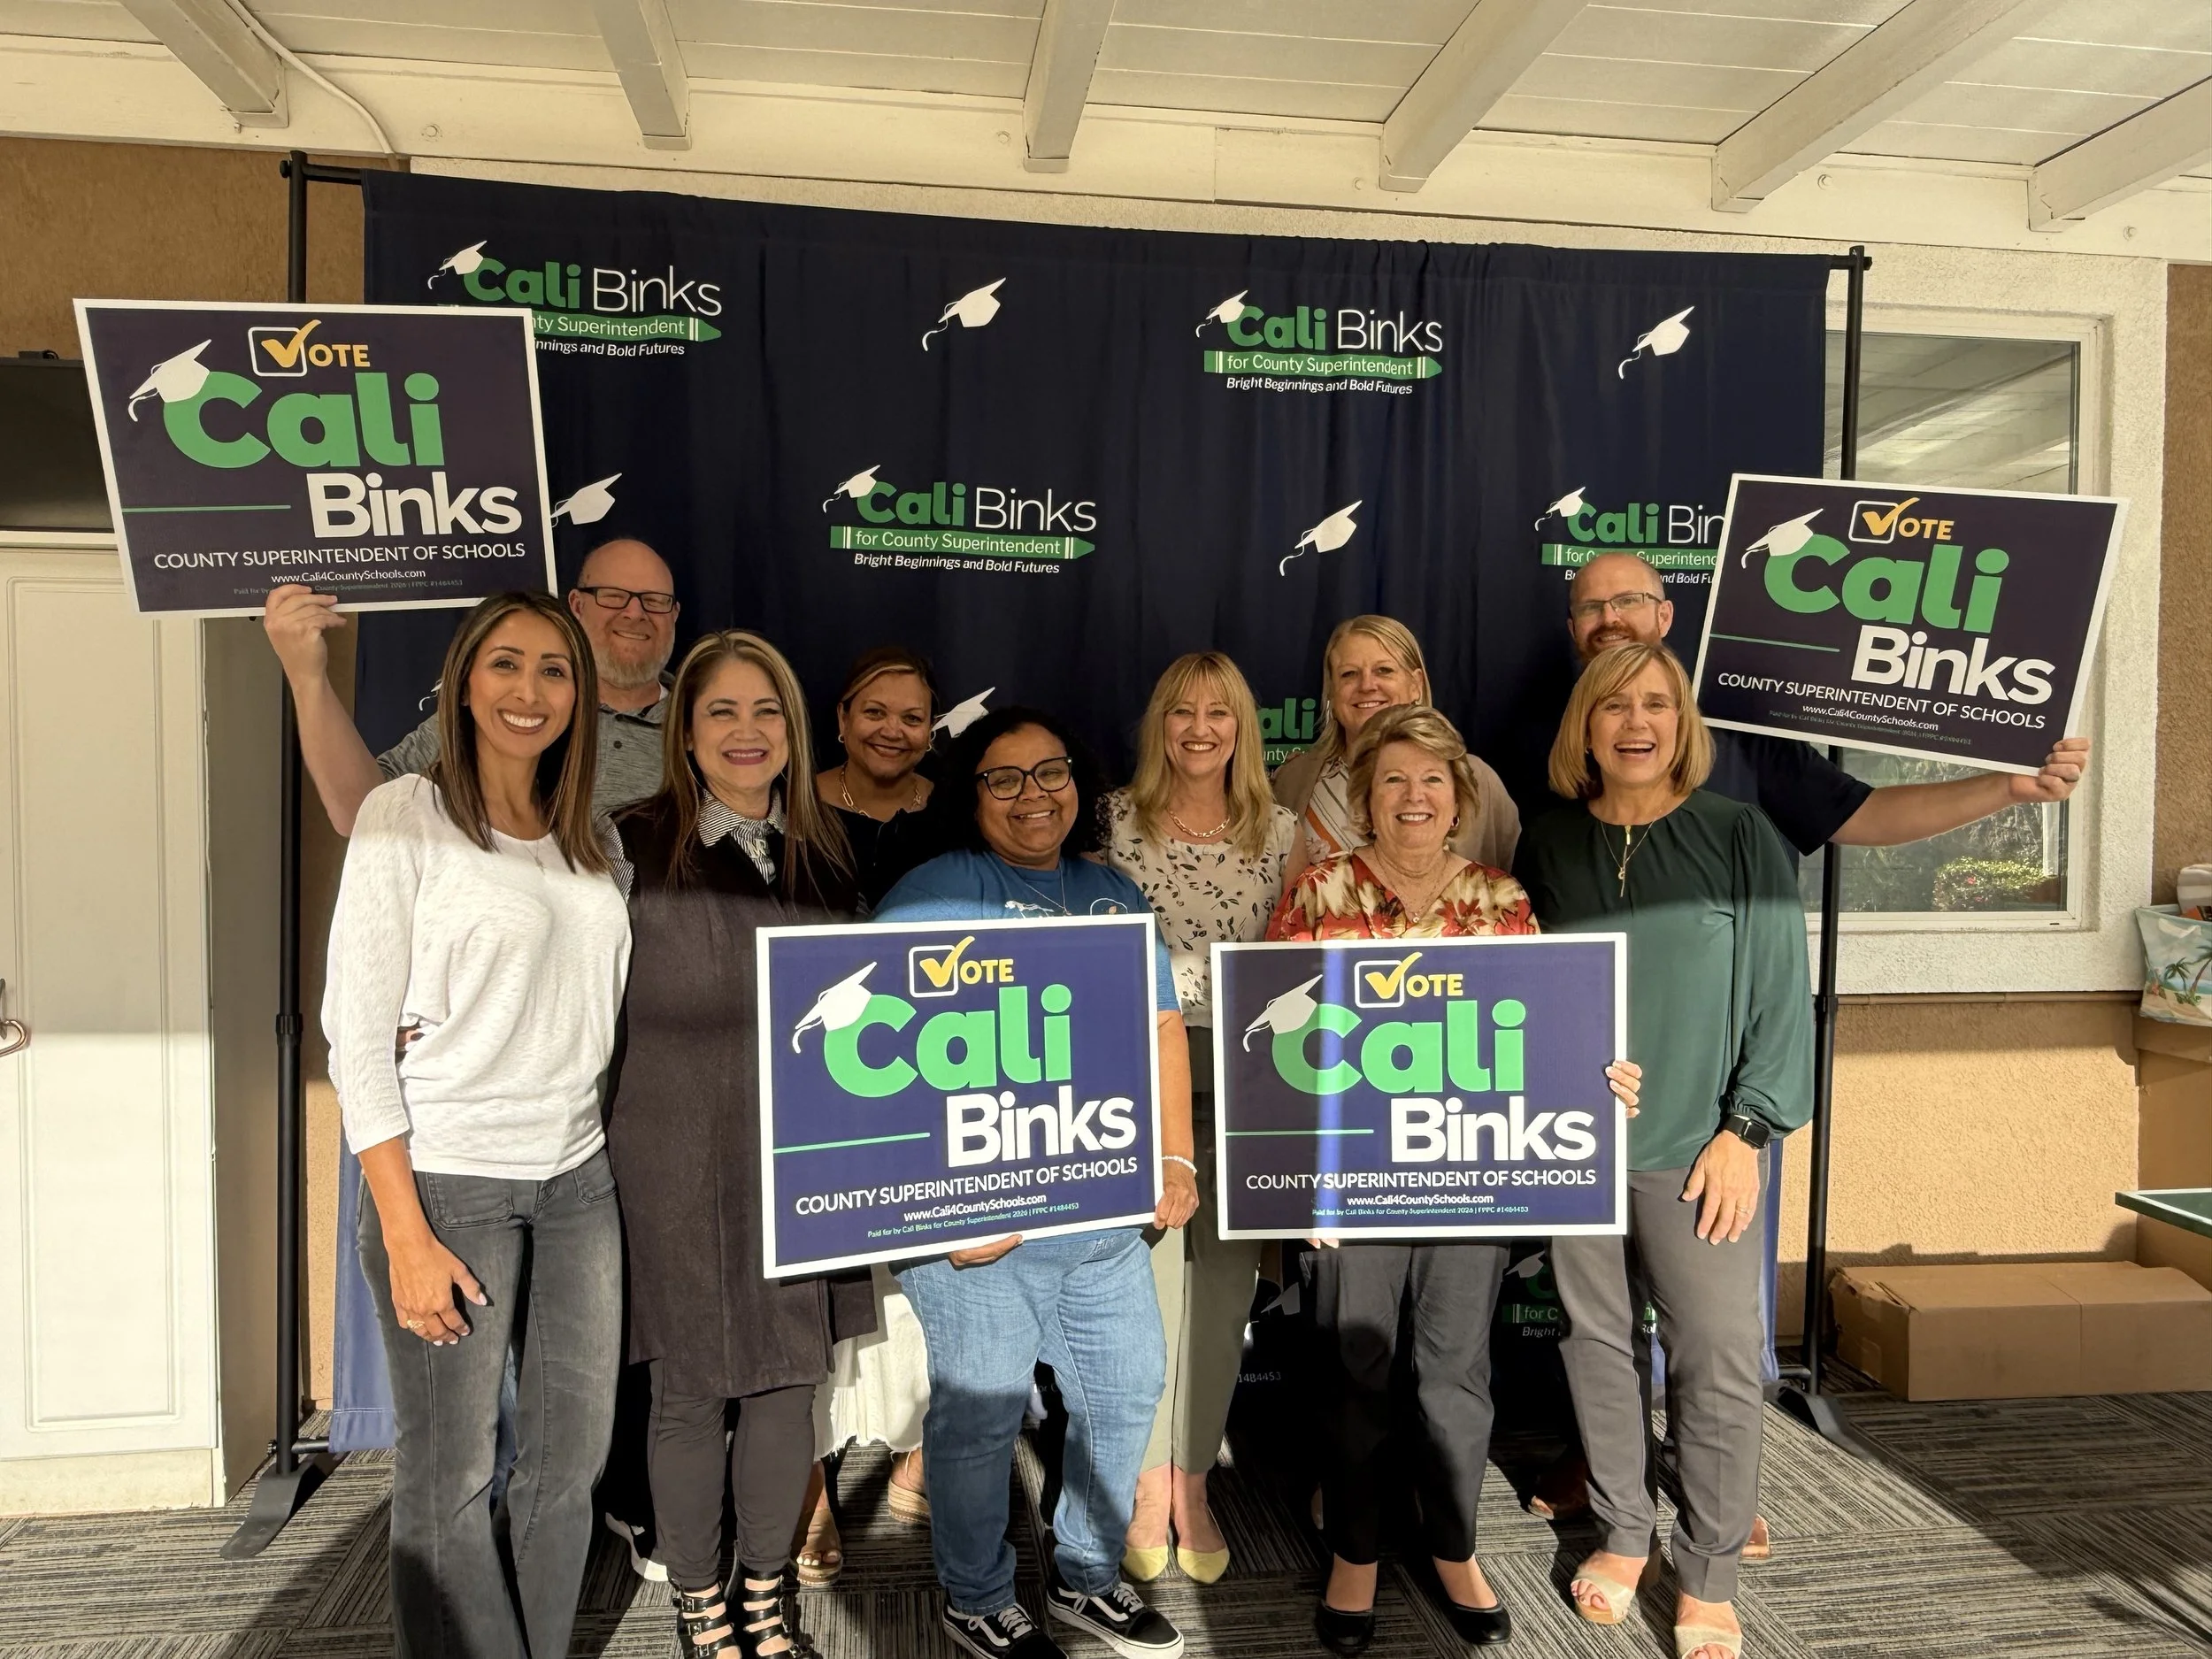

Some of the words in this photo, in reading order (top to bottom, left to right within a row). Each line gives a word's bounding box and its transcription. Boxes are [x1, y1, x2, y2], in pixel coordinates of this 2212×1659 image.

[463, 257, 581, 309] Cali
[593, 265, 723, 316] Binks
[532, 315, 554, 333] nty
[557, 316, 685, 336] Superintendent
[1226, 305, 1327, 350] Cali
[1337, 309, 1443, 352] Binks
[580, 342, 604, 355] and
[607, 344, 636, 357] Bold
[639, 343, 685, 357] Futures
[1227, 355, 1247, 369] for
[1252, 355, 1304, 373] County
[1306, 357, 1413, 375] Superintendent
[1226, 377, 1263, 391] Bright
[1264, 378, 1324, 393] Beginnings
[1326, 380, 1347, 392] and
[1349, 380, 1374, 392] Bold
[1376, 381, 1413, 395] Futures
[164, 371, 444, 468] Cali
[306, 472, 522, 538] Binks
[856, 480, 966, 526] Cali
[974, 487, 1097, 532] Binks
[1566, 502, 1660, 544] Cali
[1668, 504, 1724, 544] Bin
[856, 531, 879, 545] for
[882, 532, 939, 550] County
[941, 534, 1061, 554] Superintendent
[1565, 548, 1584, 563] for
[154, 551, 239, 570] COUNTY
[242, 547, 410, 565] SUPERINTENDENT
[413, 545, 438, 561] OF
[442, 543, 526, 559] SCHOOLS
[854, 553, 894, 567] Bright
[895, 555, 961, 571] Beginnings
[963, 558, 984, 571] and
[985, 559, 1012, 572] Bold
[1014, 561, 1060, 573] Futures
[271, 569, 426, 583] www.Cali4CountySchools.com
[1677, 573, 1699, 584] Bold
[1763, 534, 2009, 634] Cali
[1850, 625, 2055, 704] Binks
[1717, 672, 1784, 694] COUNTY
[1785, 680, 1932, 713] SUPERINTENDENT
[1933, 702, 1958, 717] OF
[1960, 705, 2046, 730] SCHOOLS
[1257, 698, 1316, 740] ali
[1802, 705, 1939, 731] www.Cali4CountySchools.com
[824, 984, 1072, 1098] Cali
[1271, 999, 1527, 1095] Cali
[946, 1085, 1137, 1168] Binks
[1390, 1095, 1597, 1163] Binks
[795, 1187, 878, 1216] COUNTY
[879, 1169, 1033, 1204] SUPERINTENDENT
[1036, 1167, 1060, 1184] OF
[1062, 1157, 1138, 1181] SCHOOLS
[1246, 1173, 1322, 1190] COUNTY
[1322, 1171, 1481, 1190] SUPERINTENDENT
[1484, 1170, 1509, 1187] OF
[1511, 1169, 1596, 1186] SCHOOLS
[903, 1194, 1047, 1221] www.Cali4CountySchools.com
[1347, 1194, 1494, 1205] www.Cali4CountySchools.com
[868, 1229, 881, 1238] Paid
[943, 1218, 965, 1228] County
[1525, 1306, 1543, 1320] for
[1522, 1326, 1555, 1338] Bright
